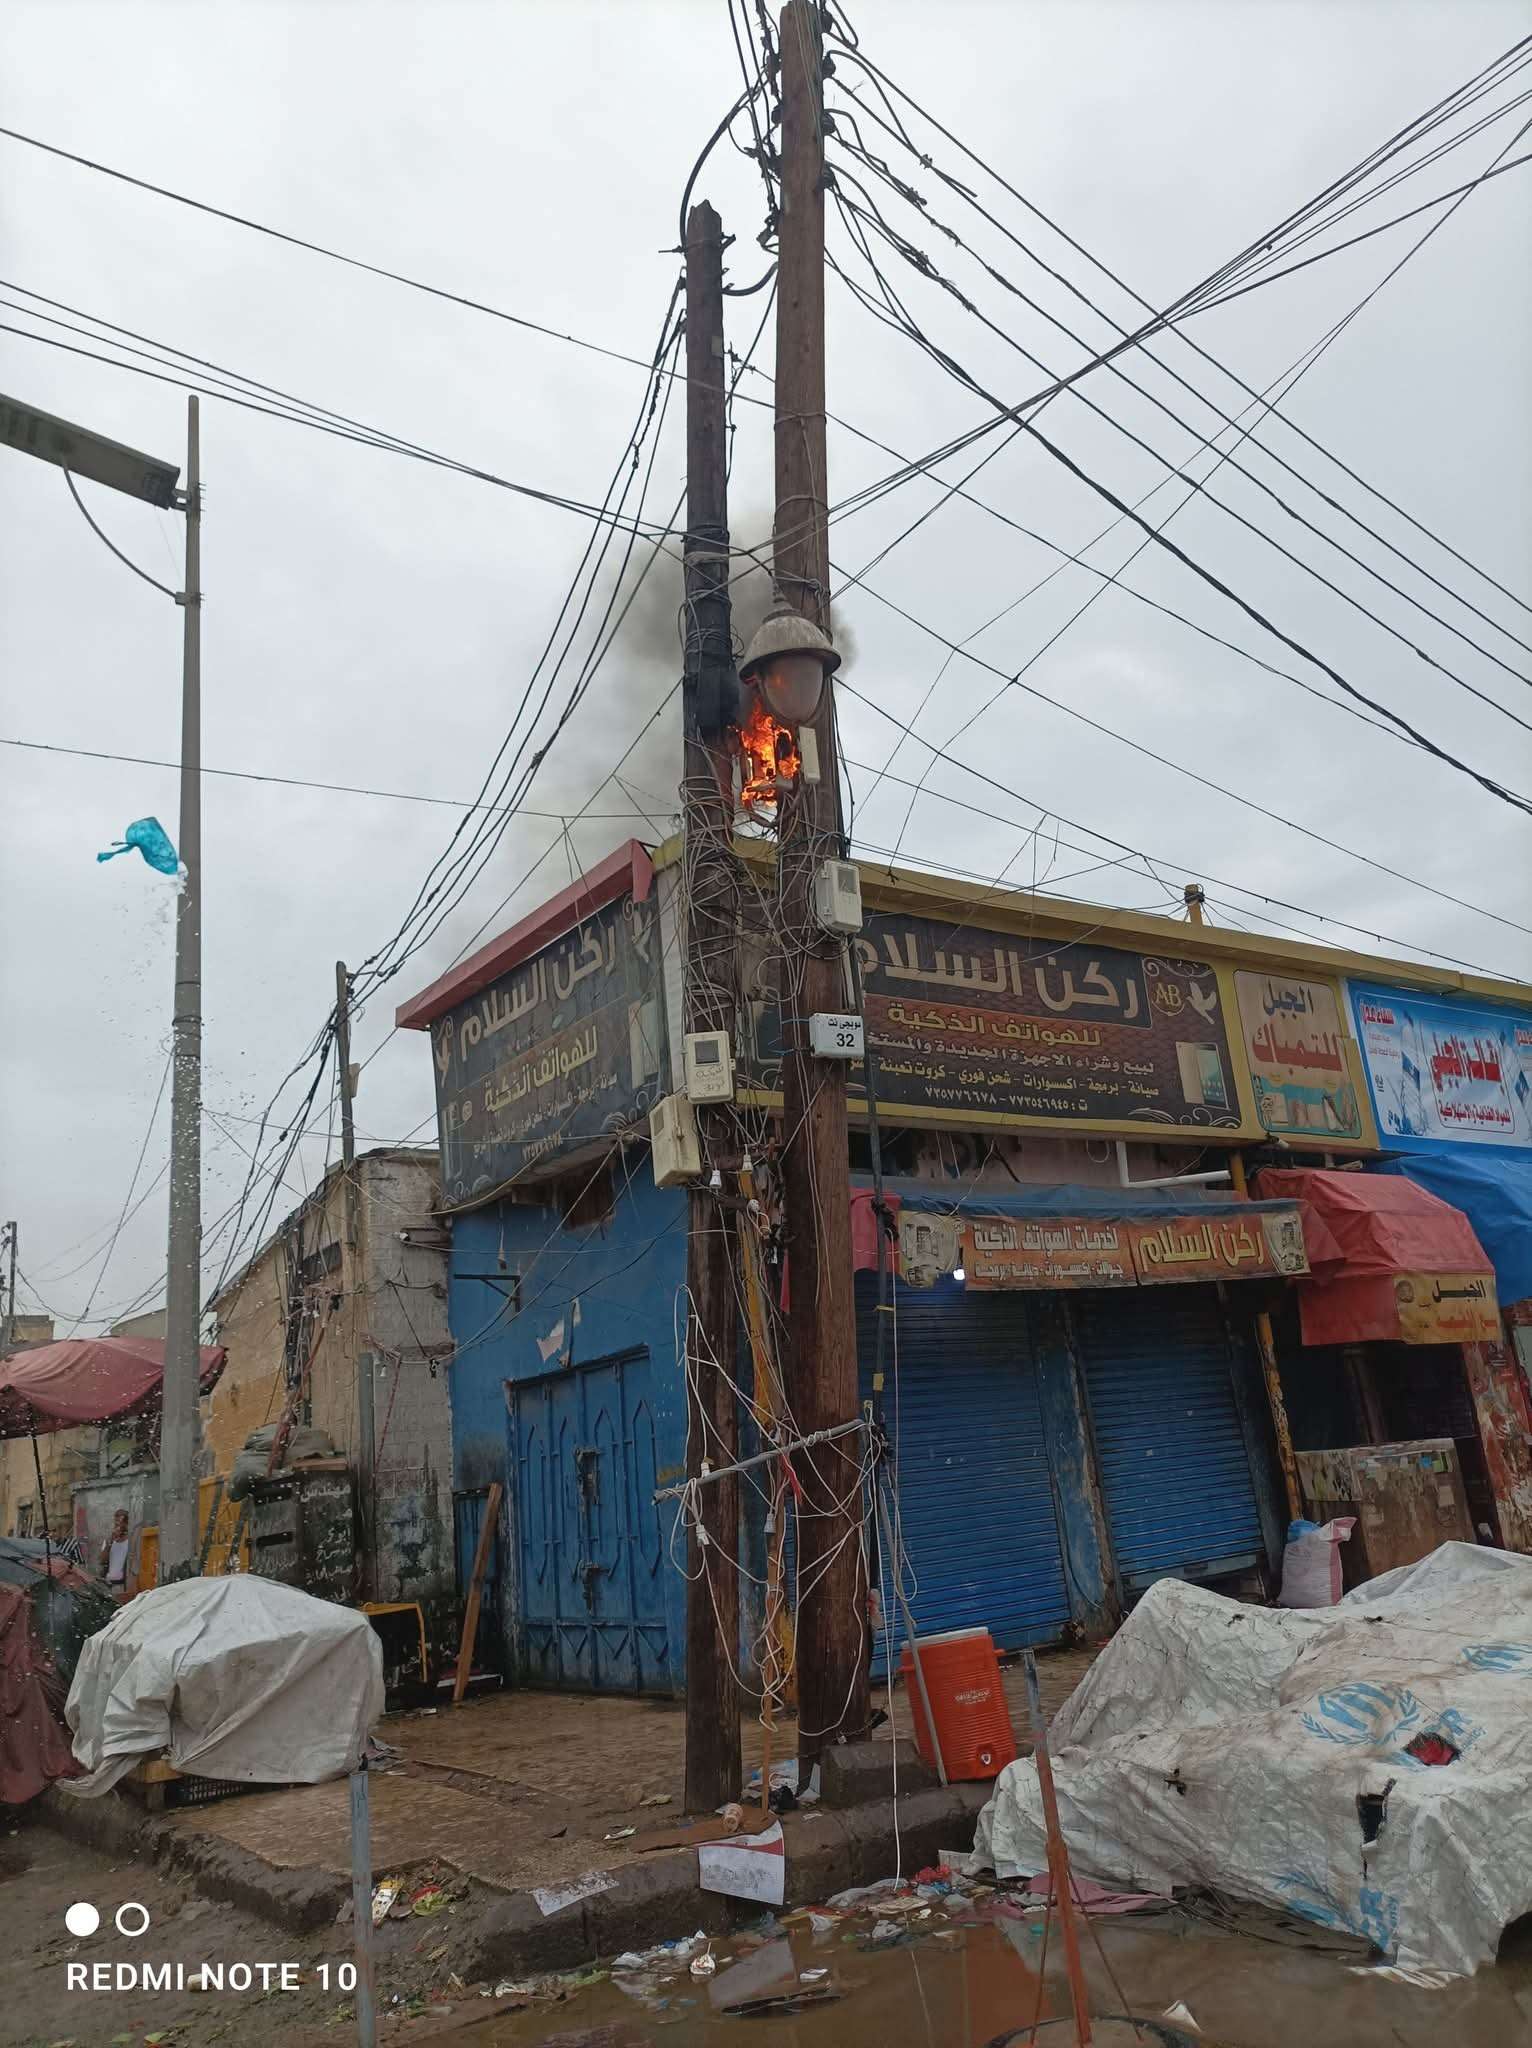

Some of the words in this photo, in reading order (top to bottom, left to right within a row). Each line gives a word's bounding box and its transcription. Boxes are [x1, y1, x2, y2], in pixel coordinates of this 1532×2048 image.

[552, 924, 617, 1000] ركن
[1035, 956, 1140, 1019] ركن
[1154, 981, 1183, 1008] AB
[460, 957, 547, 1062] السلام
[887, 1002, 985, 1034] الذكية
[836, 1033, 855, 1047] 32
[992, 1018, 1103, 1046] للهواتف
[533, 1025, 598, 1088] للهواتف
[915, 1062, 946, 1080] كروت
[1075, 1056, 1120, 1071] وشراء
[1122, 1062, 1155, 1075] لبيع
[484, 1064, 531, 1114] الذكية
[1087, 1077, 1119, 1096] برمجة
[1127, 1080, 1160, 1097] صيانة
[1138, 1223, 1218, 1273] السلام
[1219, 1222, 1264, 1267] ركن
